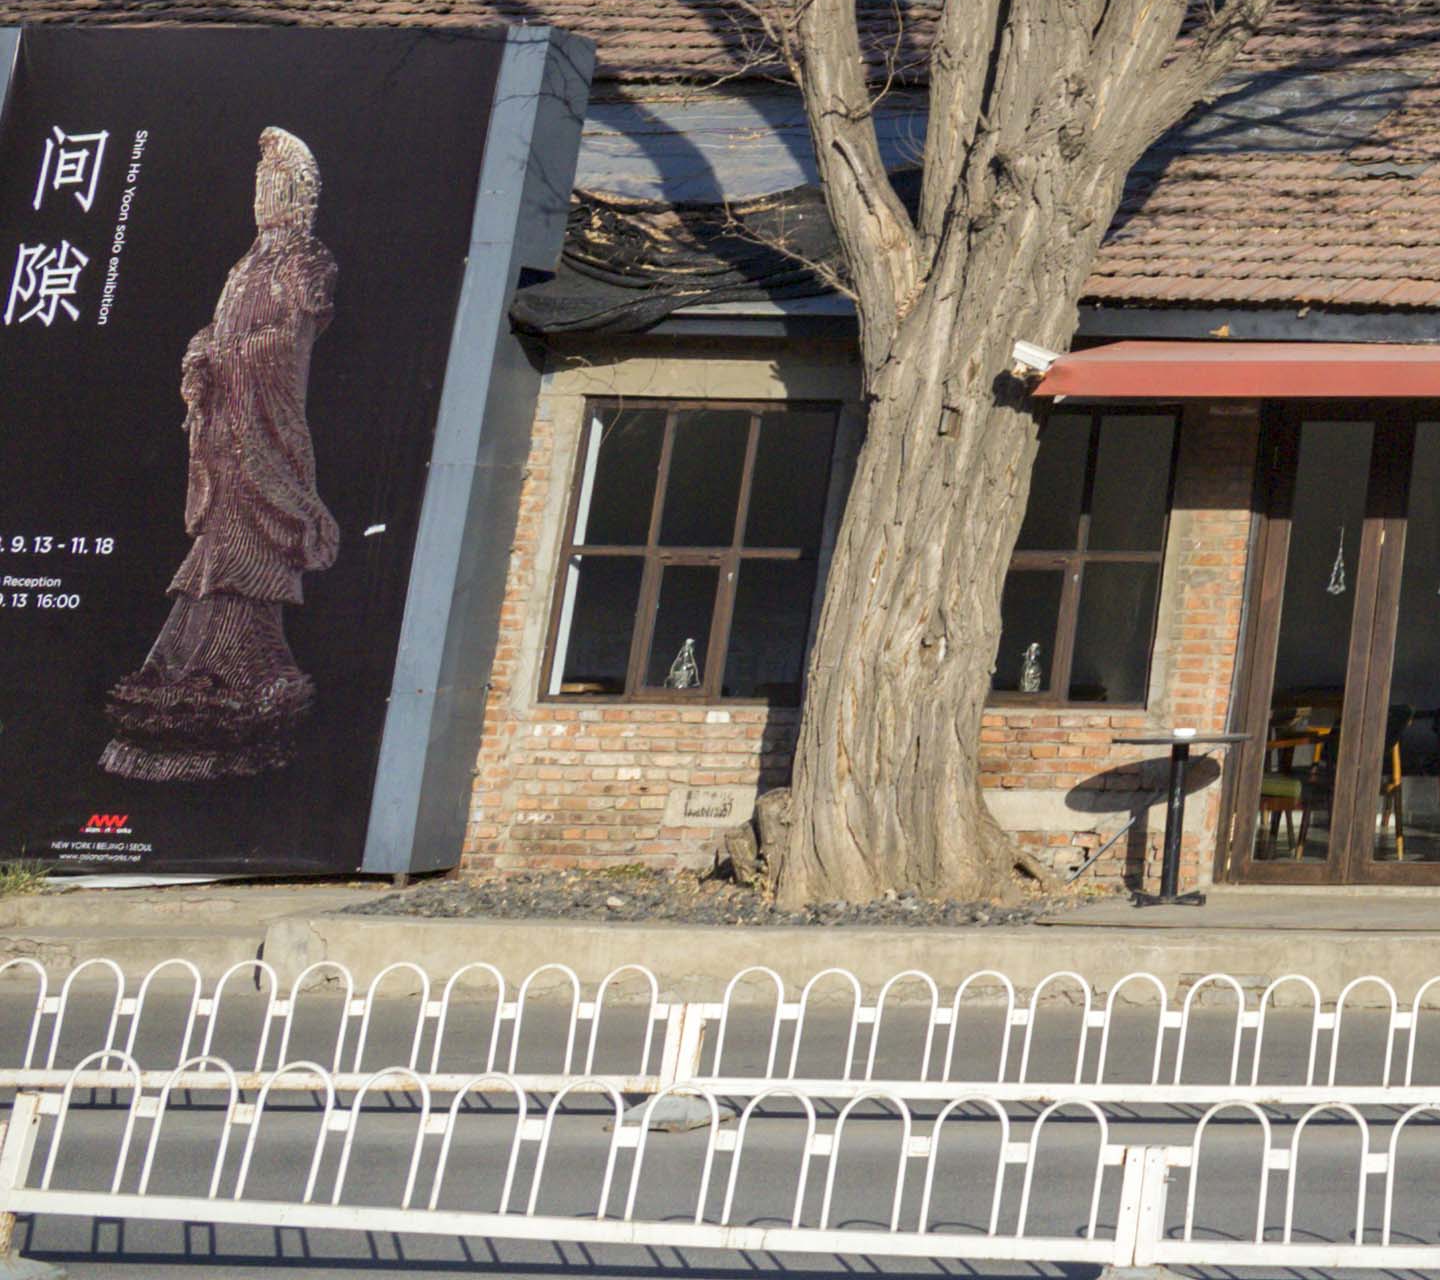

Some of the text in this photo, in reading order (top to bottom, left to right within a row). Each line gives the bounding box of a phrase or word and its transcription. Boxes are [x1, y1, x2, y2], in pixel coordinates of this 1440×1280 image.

[3, 124, 110, 328] 间隙
[97, 129, 149, 326] Shin Ho Yoon solo exhibition
[11, 535, 27, 553] 9.
[33, 536, 53, 553] 13
[71, 536, 89, 554] 11.
[94, 537, 114, 555] 18
[3, 576, 61, 589] Reception
[11, 593, 28, 608] 13
[37, 594, 80, 609] 16:00
[51, 841, 69, 849] NEW
[71, 841, 91, 850] YORK
[129, 843, 152, 852] SEOUL
